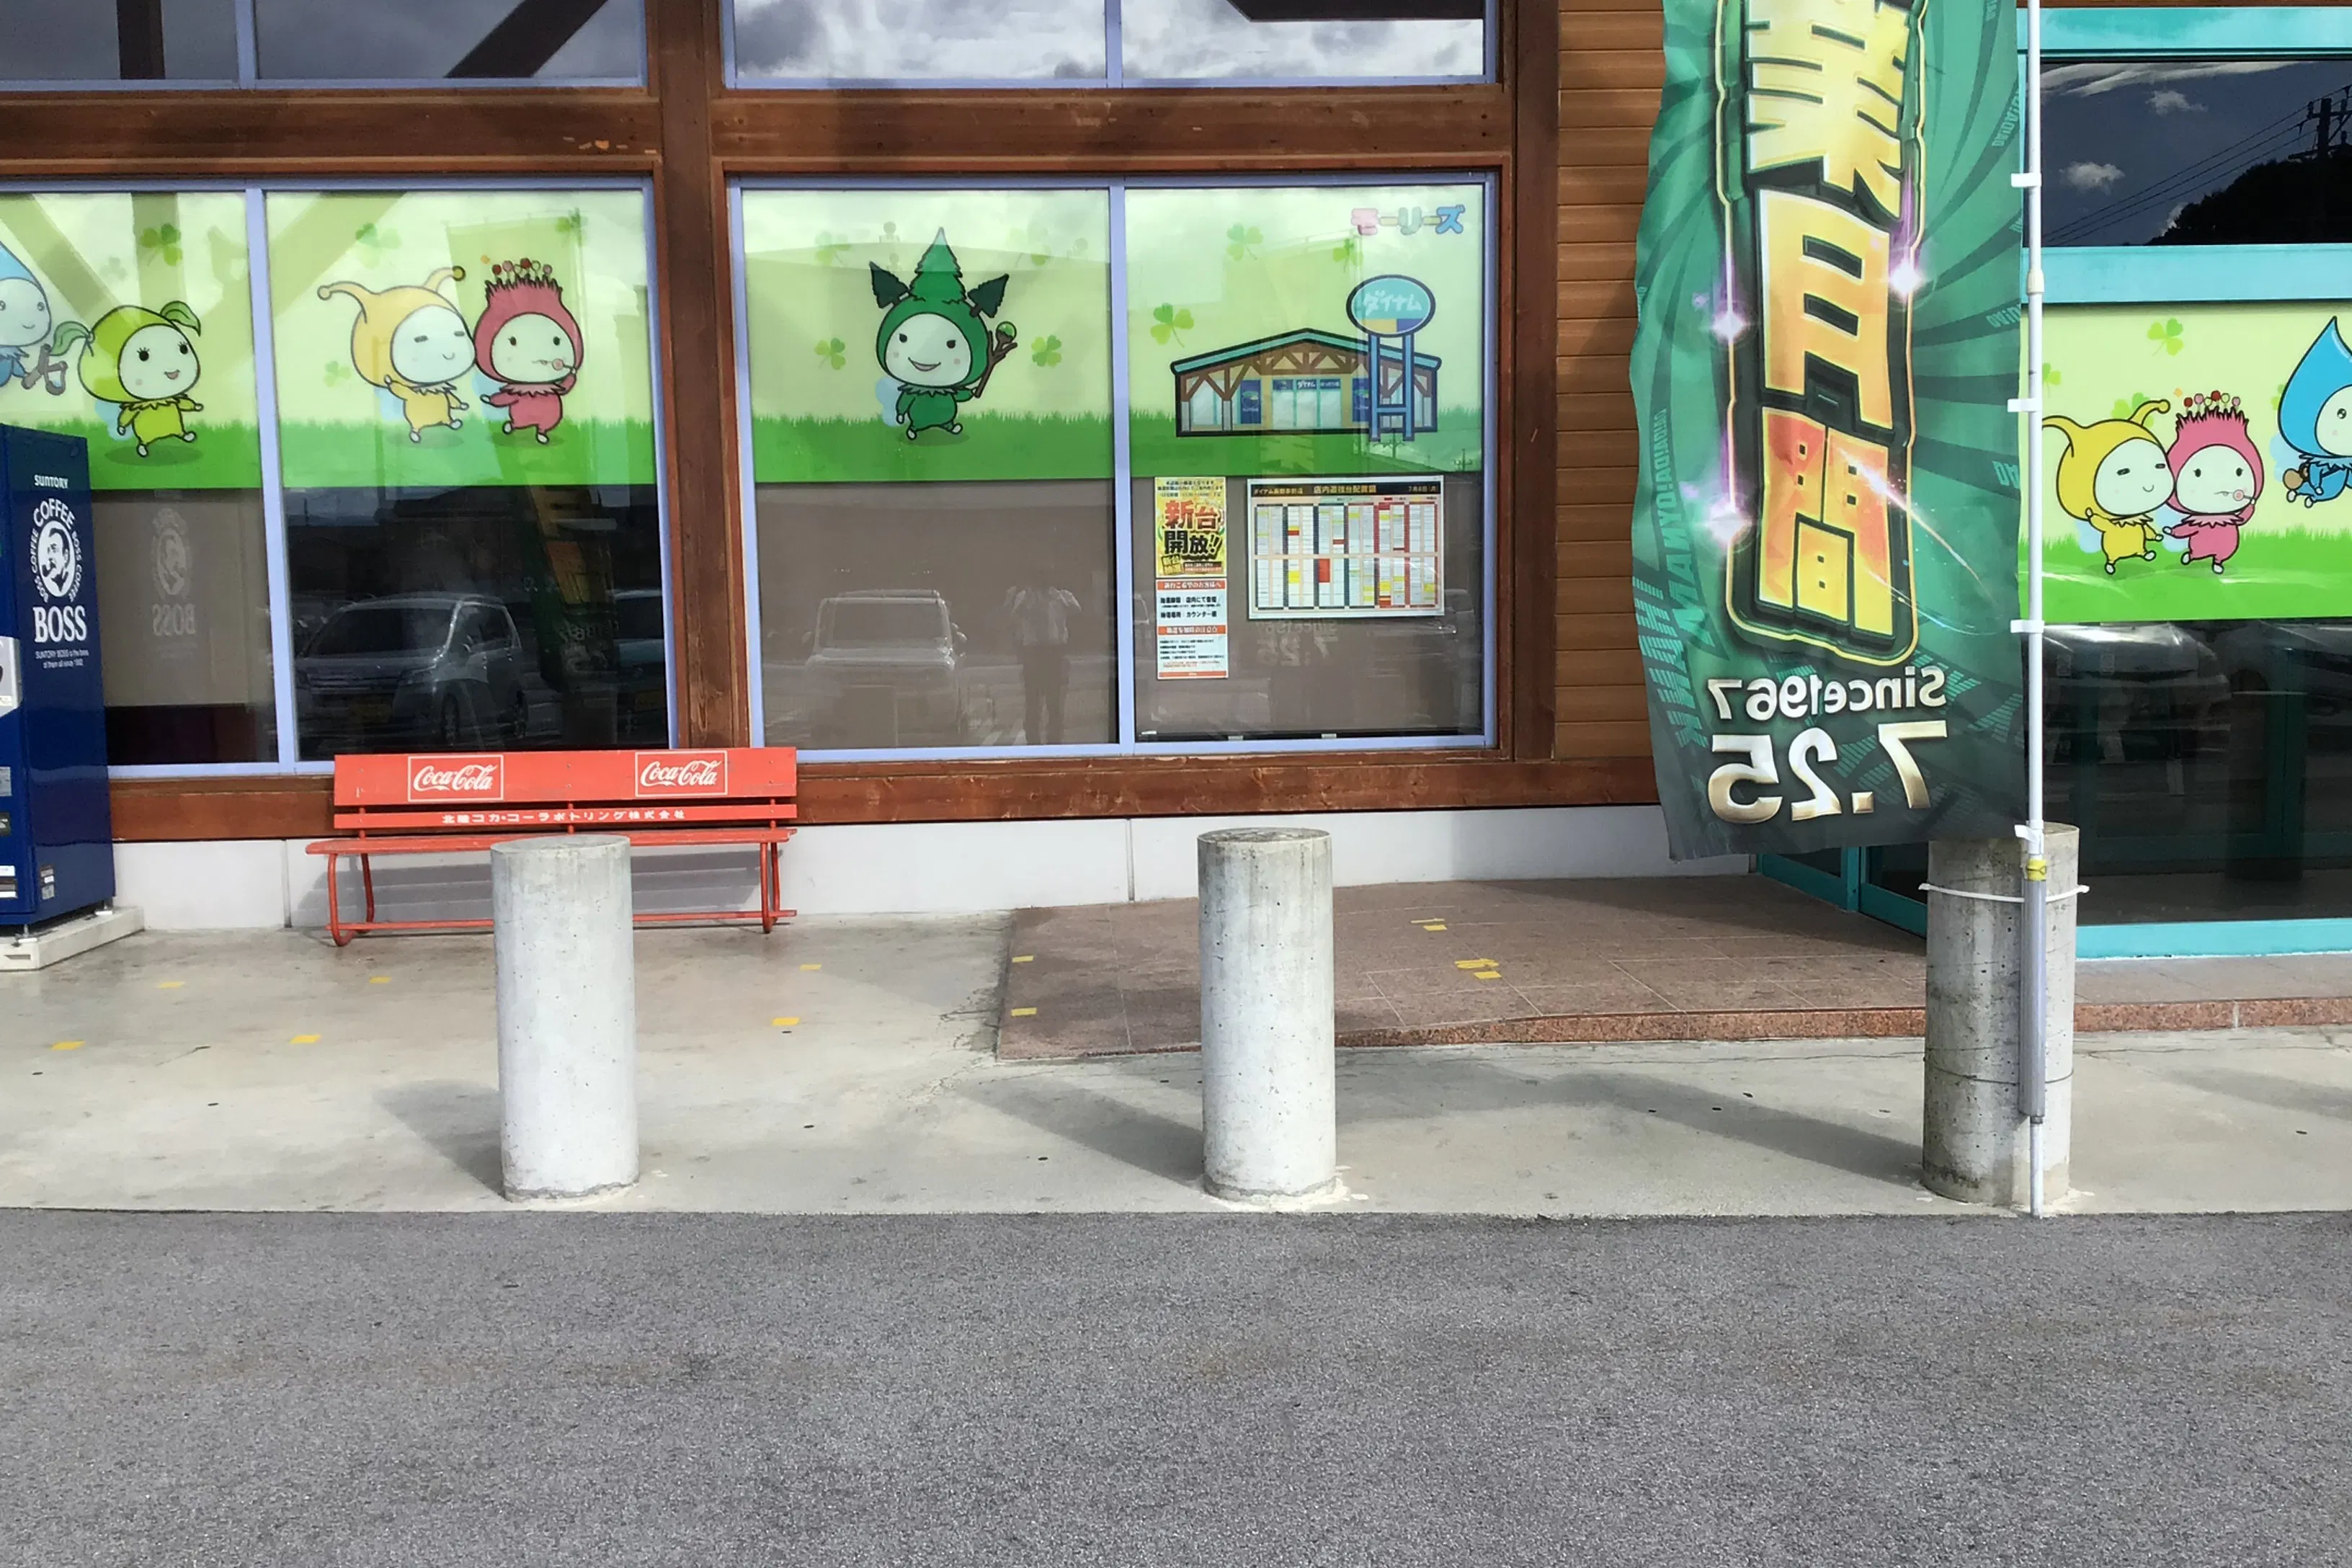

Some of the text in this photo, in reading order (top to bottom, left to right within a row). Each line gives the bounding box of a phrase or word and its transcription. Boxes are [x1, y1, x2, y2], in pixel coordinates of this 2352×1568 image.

[1351, 204, 1465, 236] モーリーズ
[1363, 290, 1422, 316] ダイナム
[34, 498, 75, 530] COFFEE
[1162, 499, 1218, 530] 新台
[32, 605, 87, 643] BOSS
[413, 764, 498, 791] Coca-Cola
[640, 760, 722, 788] Coca-Cola
